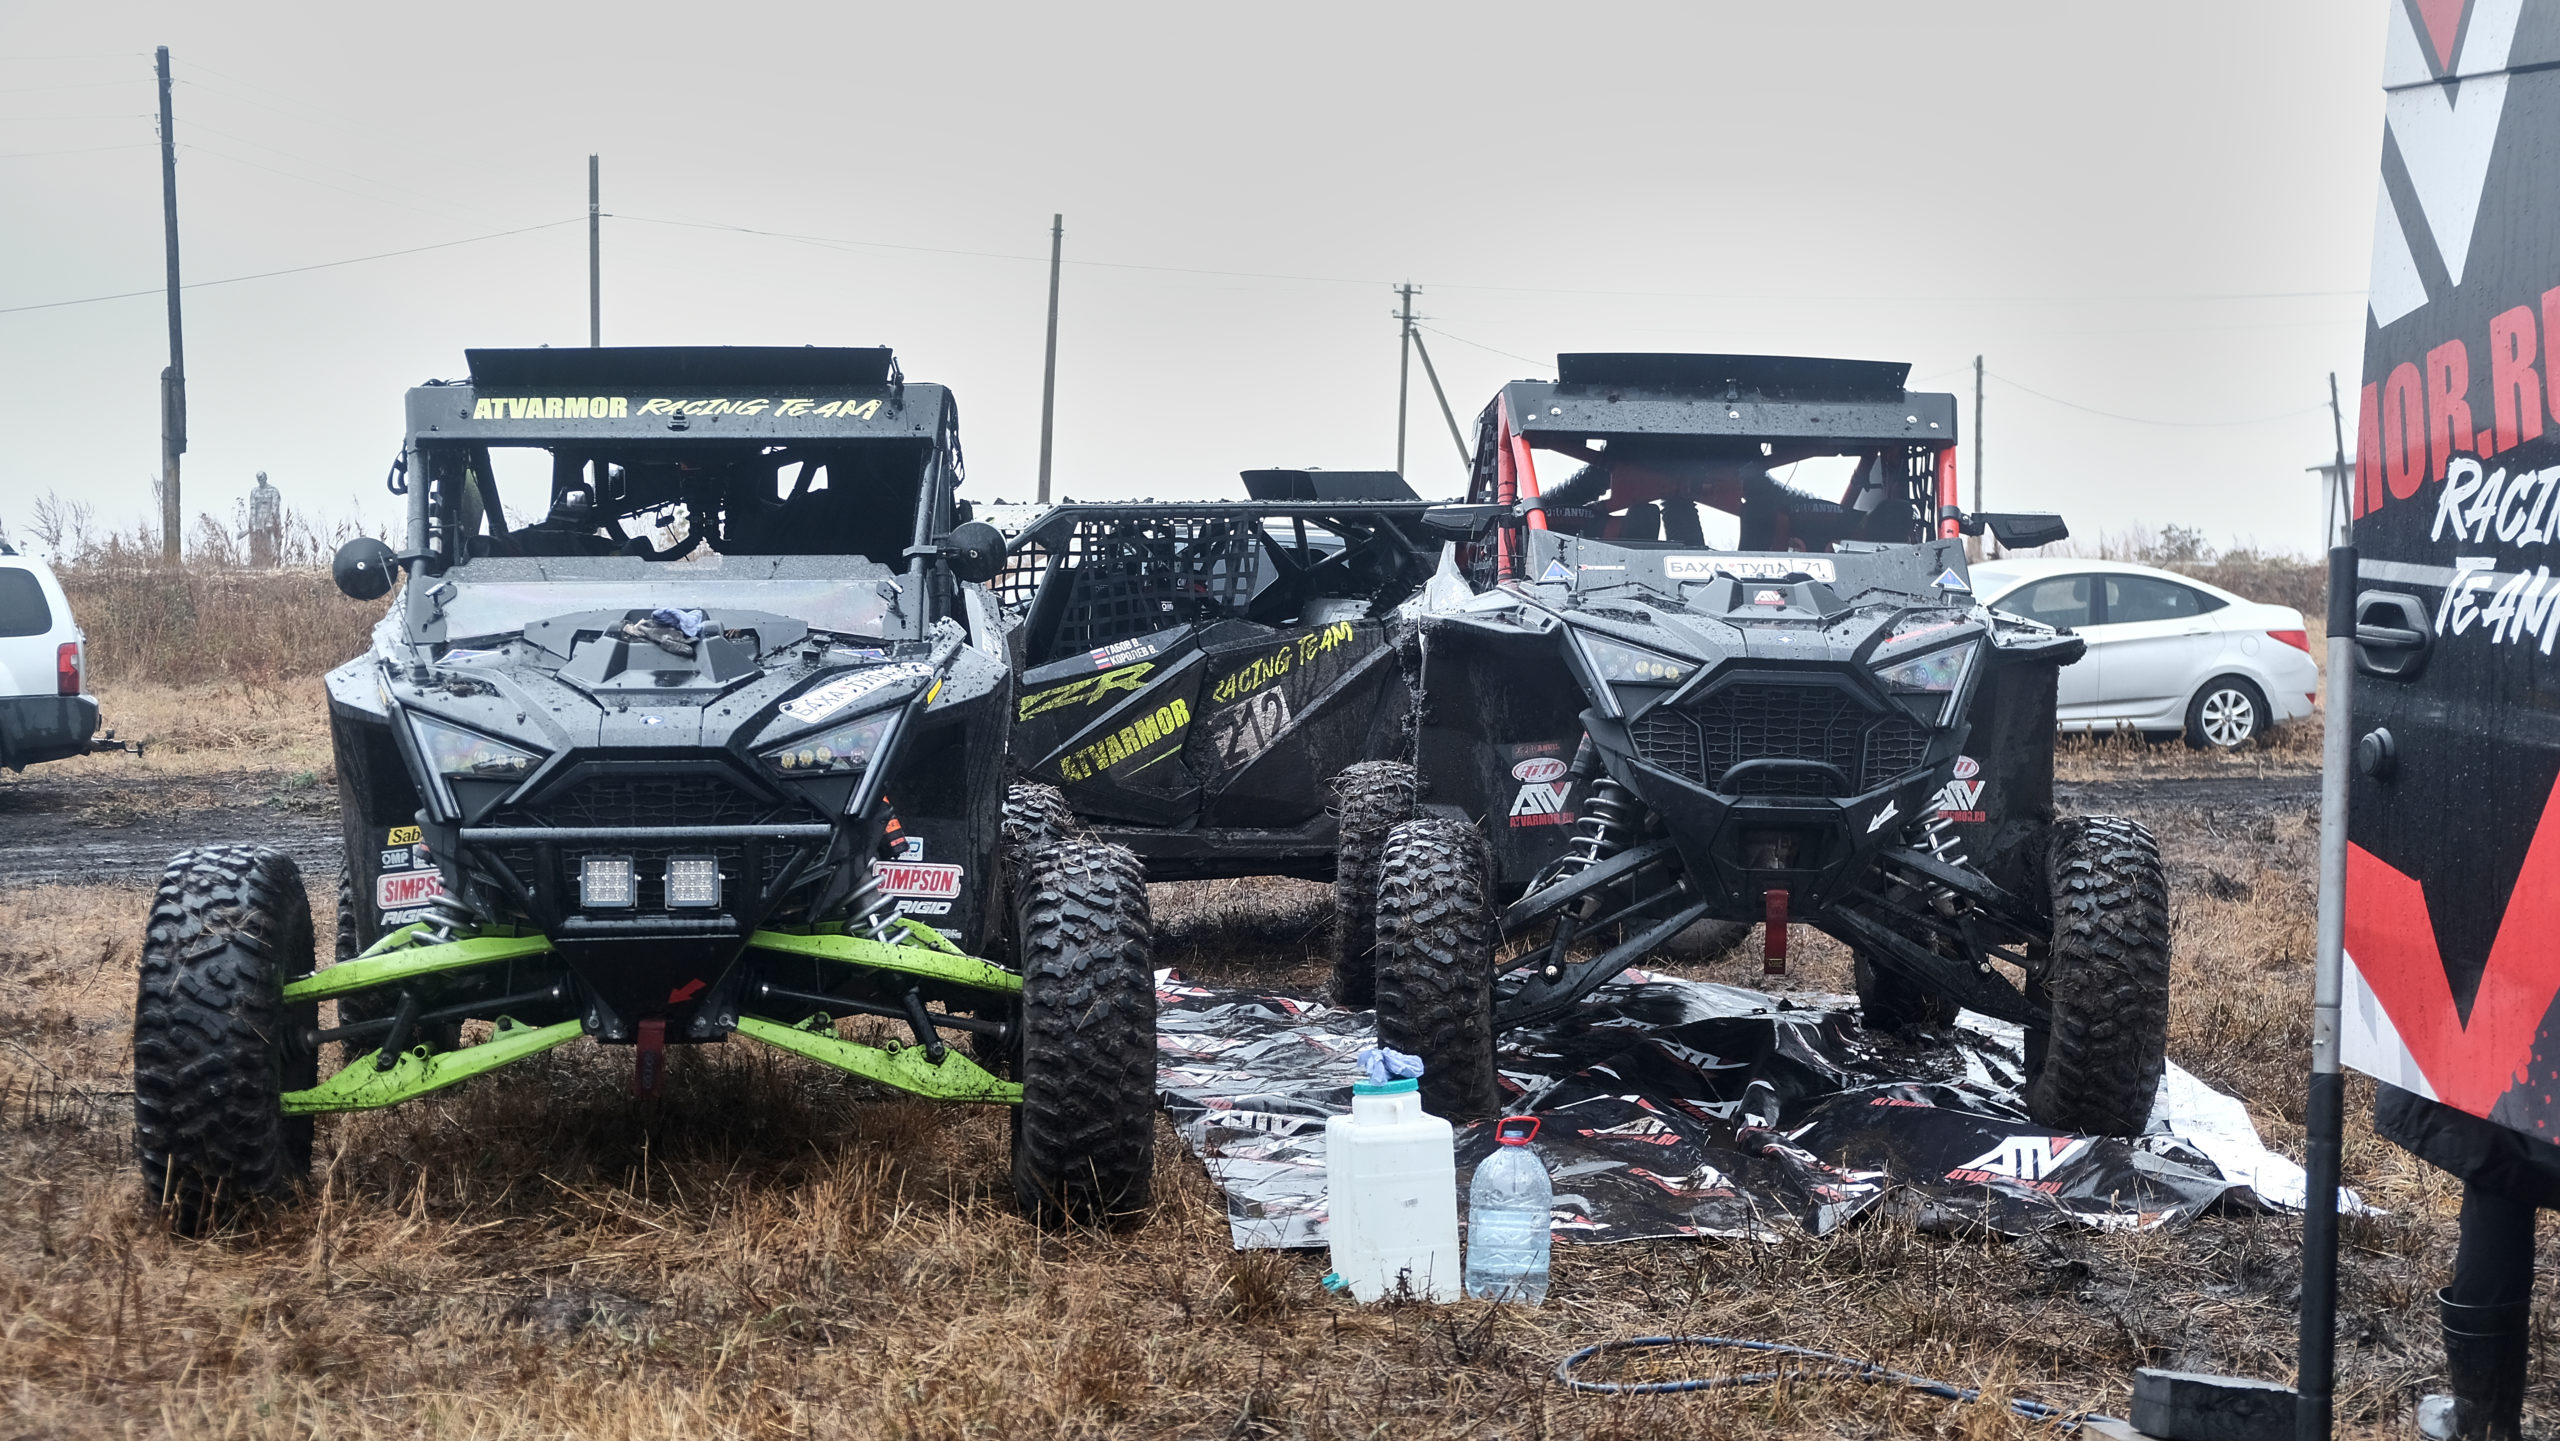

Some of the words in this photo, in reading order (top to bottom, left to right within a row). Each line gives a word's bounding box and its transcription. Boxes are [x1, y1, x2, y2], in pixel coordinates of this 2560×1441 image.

[473, 397, 628, 420] ATVARMOR
[636, 398, 770, 416] RACING
[774, 398, 882, 421] TEAM
[1801, 562, 1823, 573] 71
[1104, 640, 1133, 656] ГАБОВ
[1297, 621, 1353, 665] TEAM
[1110, 646, 1150, 666] КОРОЛЕВ
[1509, 781, 1573, 816] ATV
[392, 828, 421, 844] Sab
[381, 850, 409, 867] OMP
[877, 868, 955, 892] SIMPSON
[894, 901, 952, 915] RIGID
[1956, 1136, 2090, 1181] ATV
